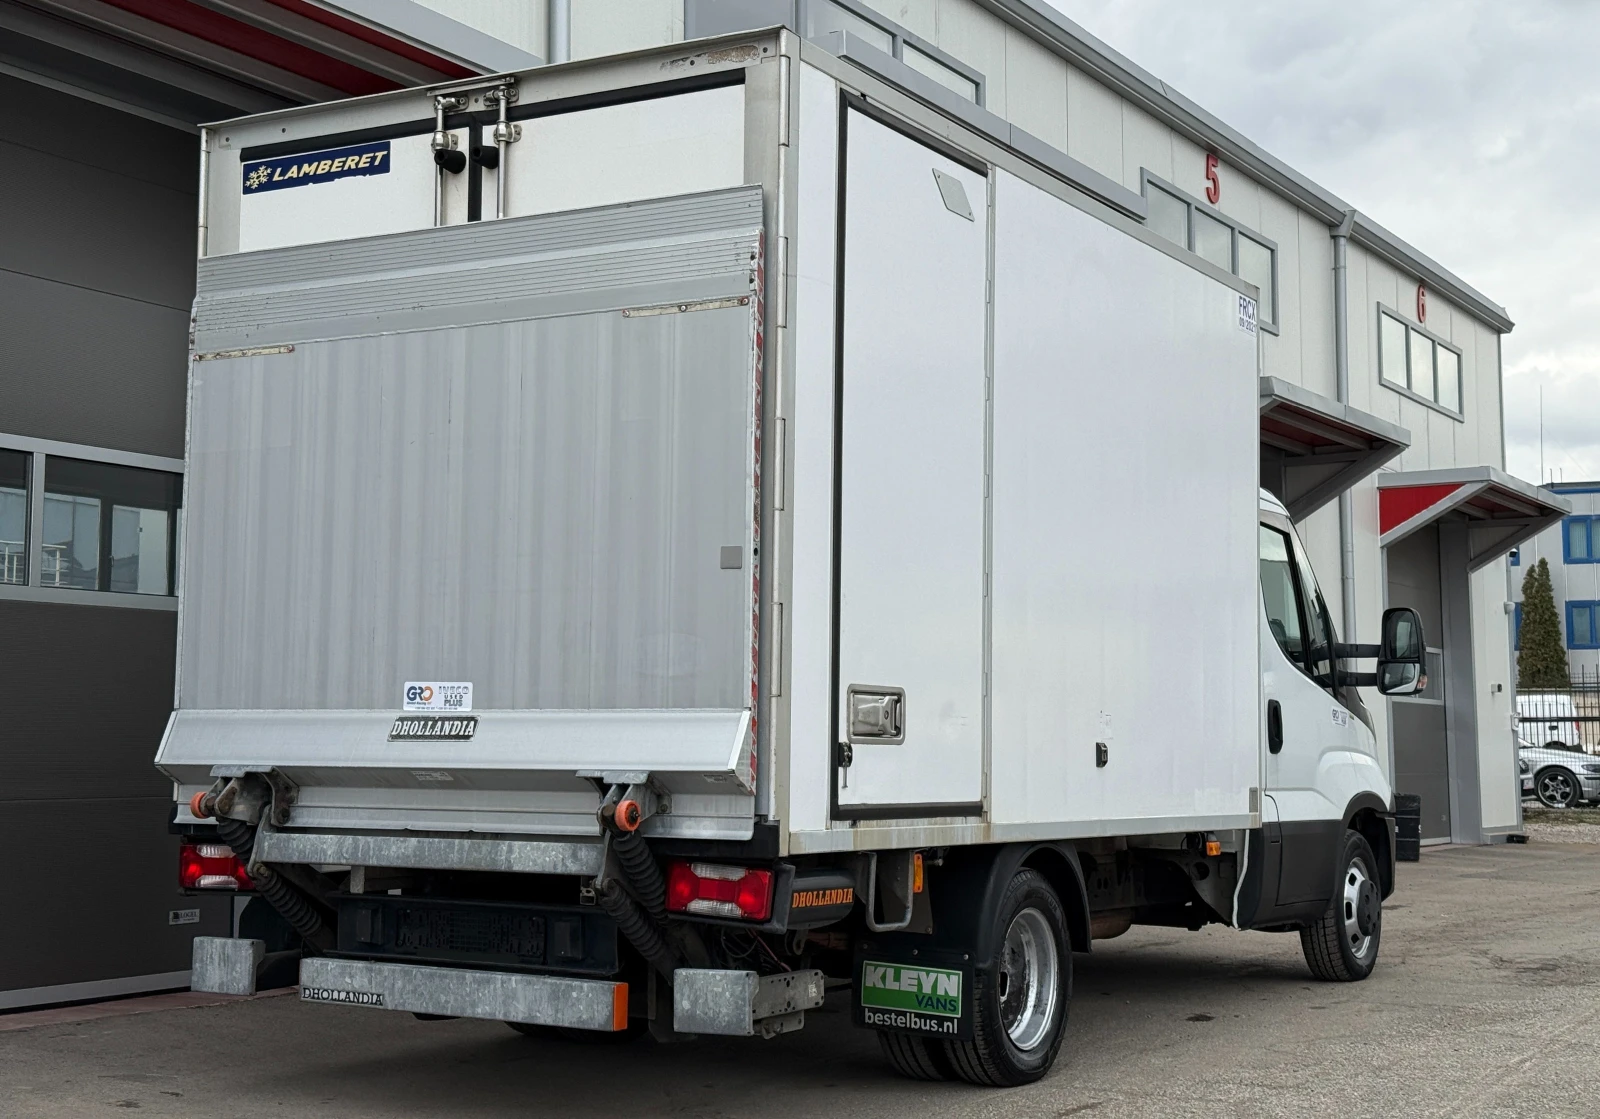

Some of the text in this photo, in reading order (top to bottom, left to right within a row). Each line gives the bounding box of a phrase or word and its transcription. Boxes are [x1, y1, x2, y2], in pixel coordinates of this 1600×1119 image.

[272, 151, 388, 181] LAMBERET
[1206, 153, 1220, 204] 5
[1239, 295, 1256, 321] FRCX
[1417, 284, 1427, 324] 6
[406, 686, 433, 701] GRO
[439, 686, 469, 695] IVECO
[444, 699, 463, 707] PLUS
[391, 720, 475, 735] DHOLLANDIA
[792, 888, 853, 908] DHOLLANDIA
[865, 965, 959, 997] KLEYN
[302, 987, 384, 1006] DHOLLANDIA
[915, 994, 957, 1013] VANS
[864, 1008, 958, 1034] bestelbus.nl
